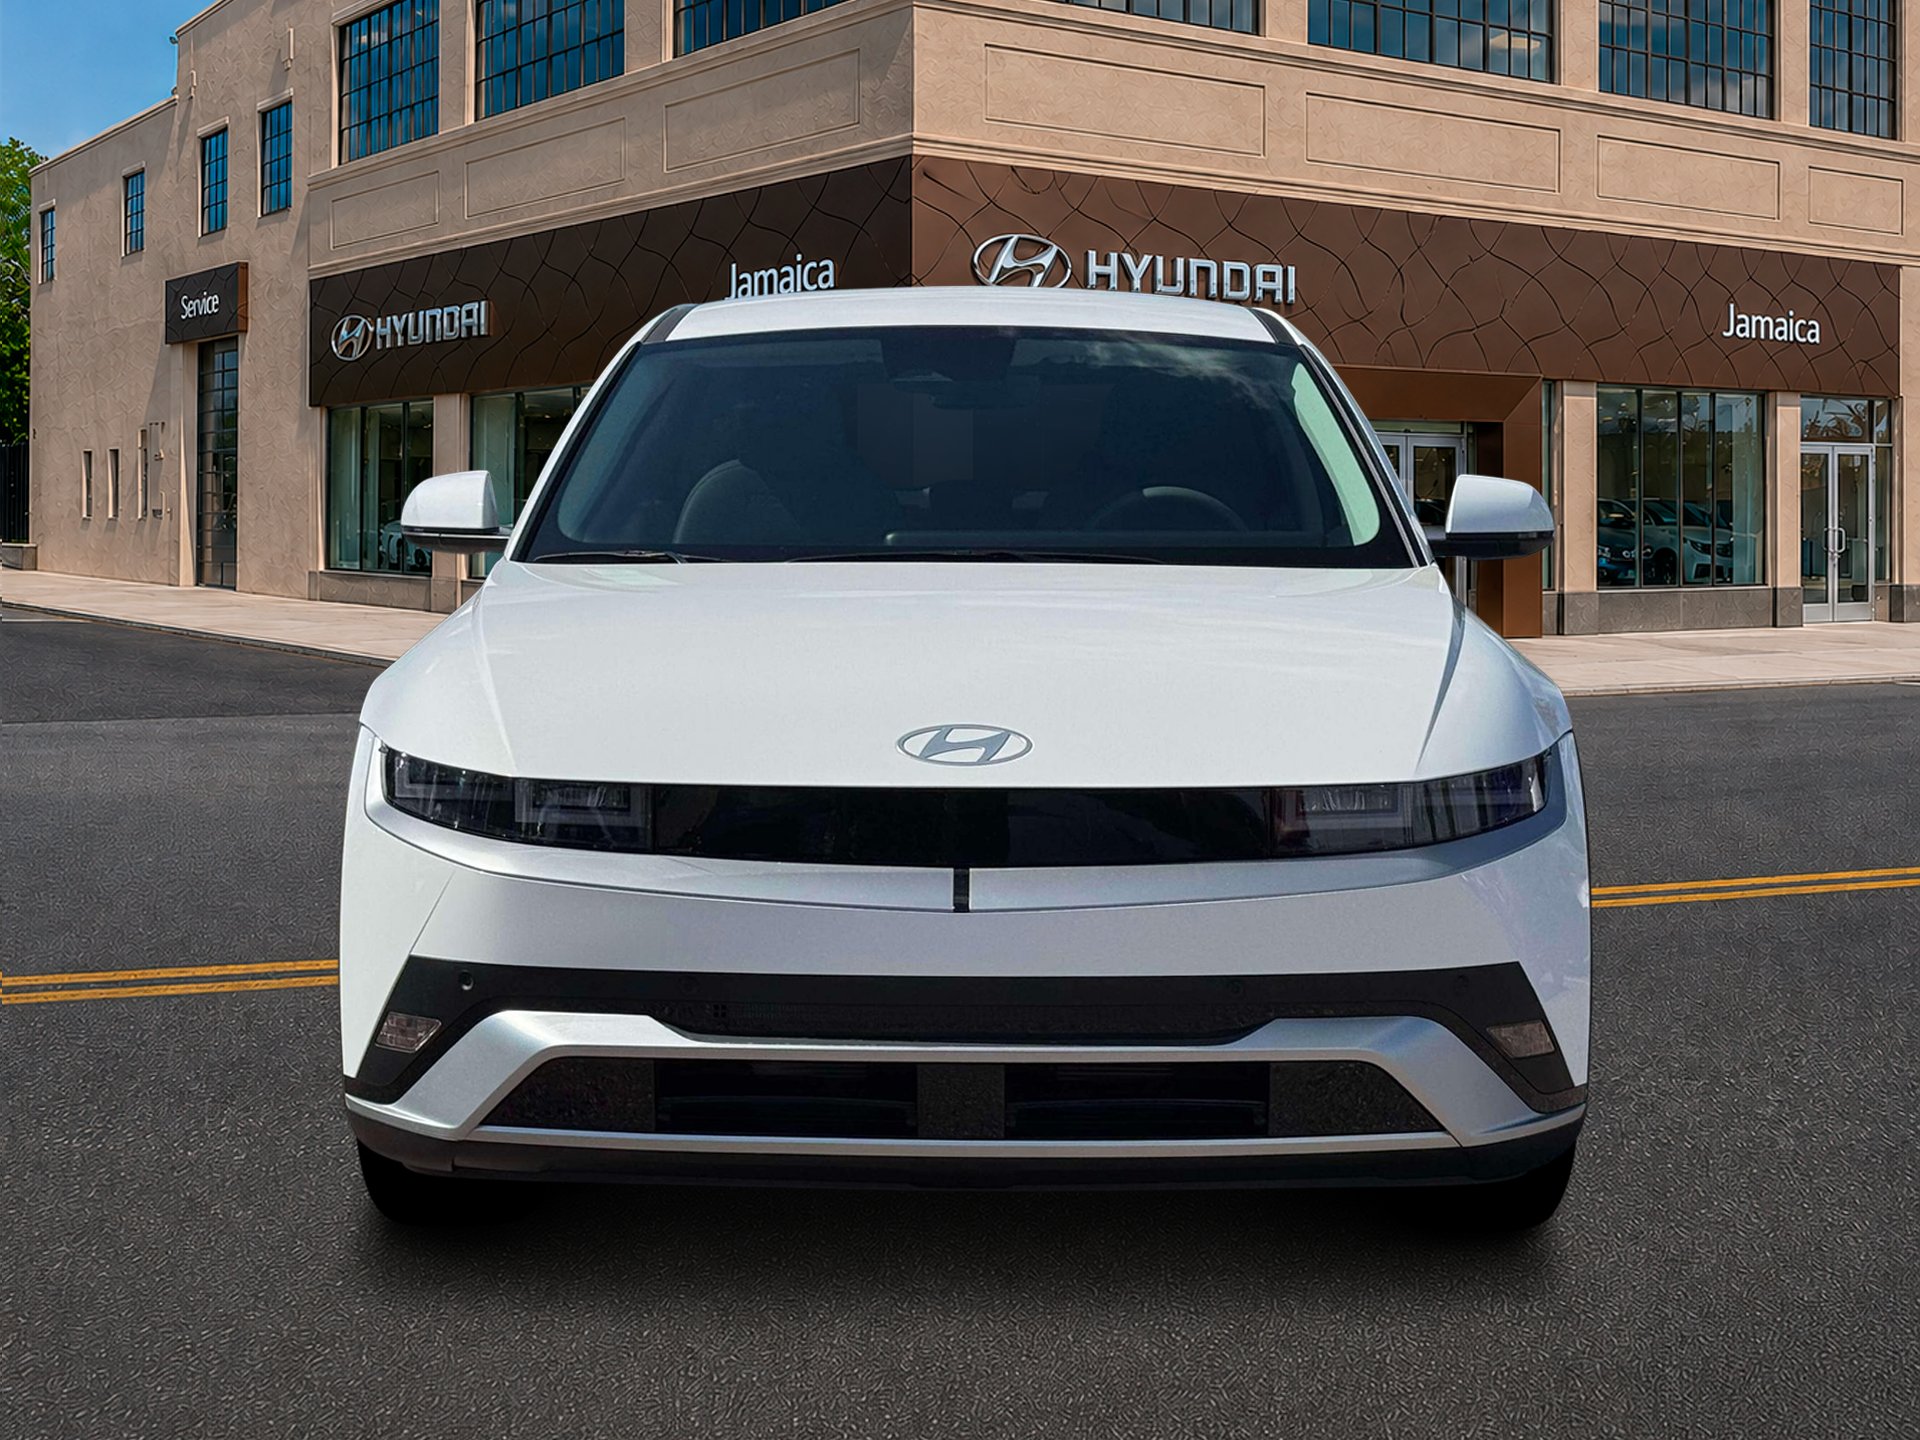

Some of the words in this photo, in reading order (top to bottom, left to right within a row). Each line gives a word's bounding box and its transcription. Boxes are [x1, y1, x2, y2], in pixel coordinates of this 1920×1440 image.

[724, 253, 835, 300] Jamaica
[1086, 249, 1296, 304] HYUNDAI
[180, 291, 220, 320] Service
[376, 300, 489, 350] HYUNDAI
[1722, 303, 1820, 344] Jamaica
